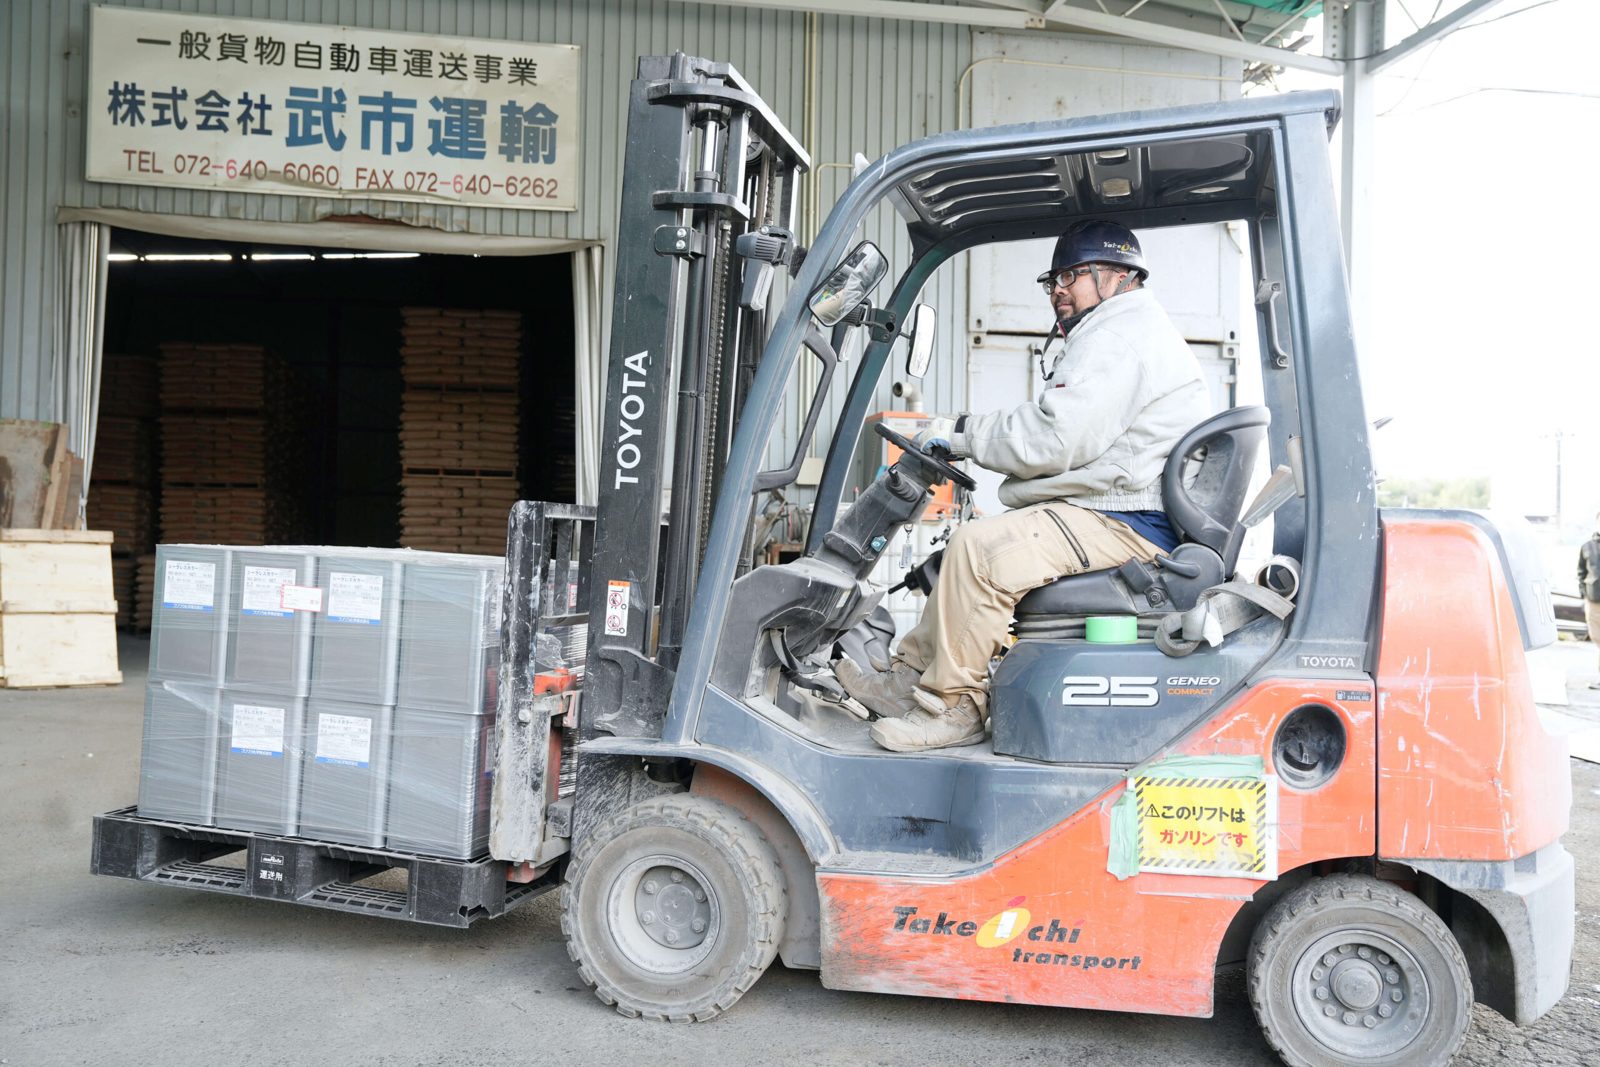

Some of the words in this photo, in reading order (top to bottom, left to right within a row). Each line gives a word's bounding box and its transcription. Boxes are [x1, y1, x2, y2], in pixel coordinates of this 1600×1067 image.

[137, 29, 538, 86] 一般貨物自動車運送事業
[123, 149, 164, 175] TEL
[174, 154, 340, 187] 072-640-6060
[355, 168, 395, 190] FAX
[404, 171, 559, 199] 072-640-6262
[614, 349, 649, 490] TOYOTA
[1301, 656, 1355, 668] TOYOTA
[1062, 676, 1160, 706] 25
[1166, 676, 1221, 686] GENEO
[1167, 688, 1215, 696] COMPACT
[1161, 804, 1246, 823] このリフトは
[1160, 829, 1248, 848] ガソリンです
[1012, 948, 1143, 970] transport
